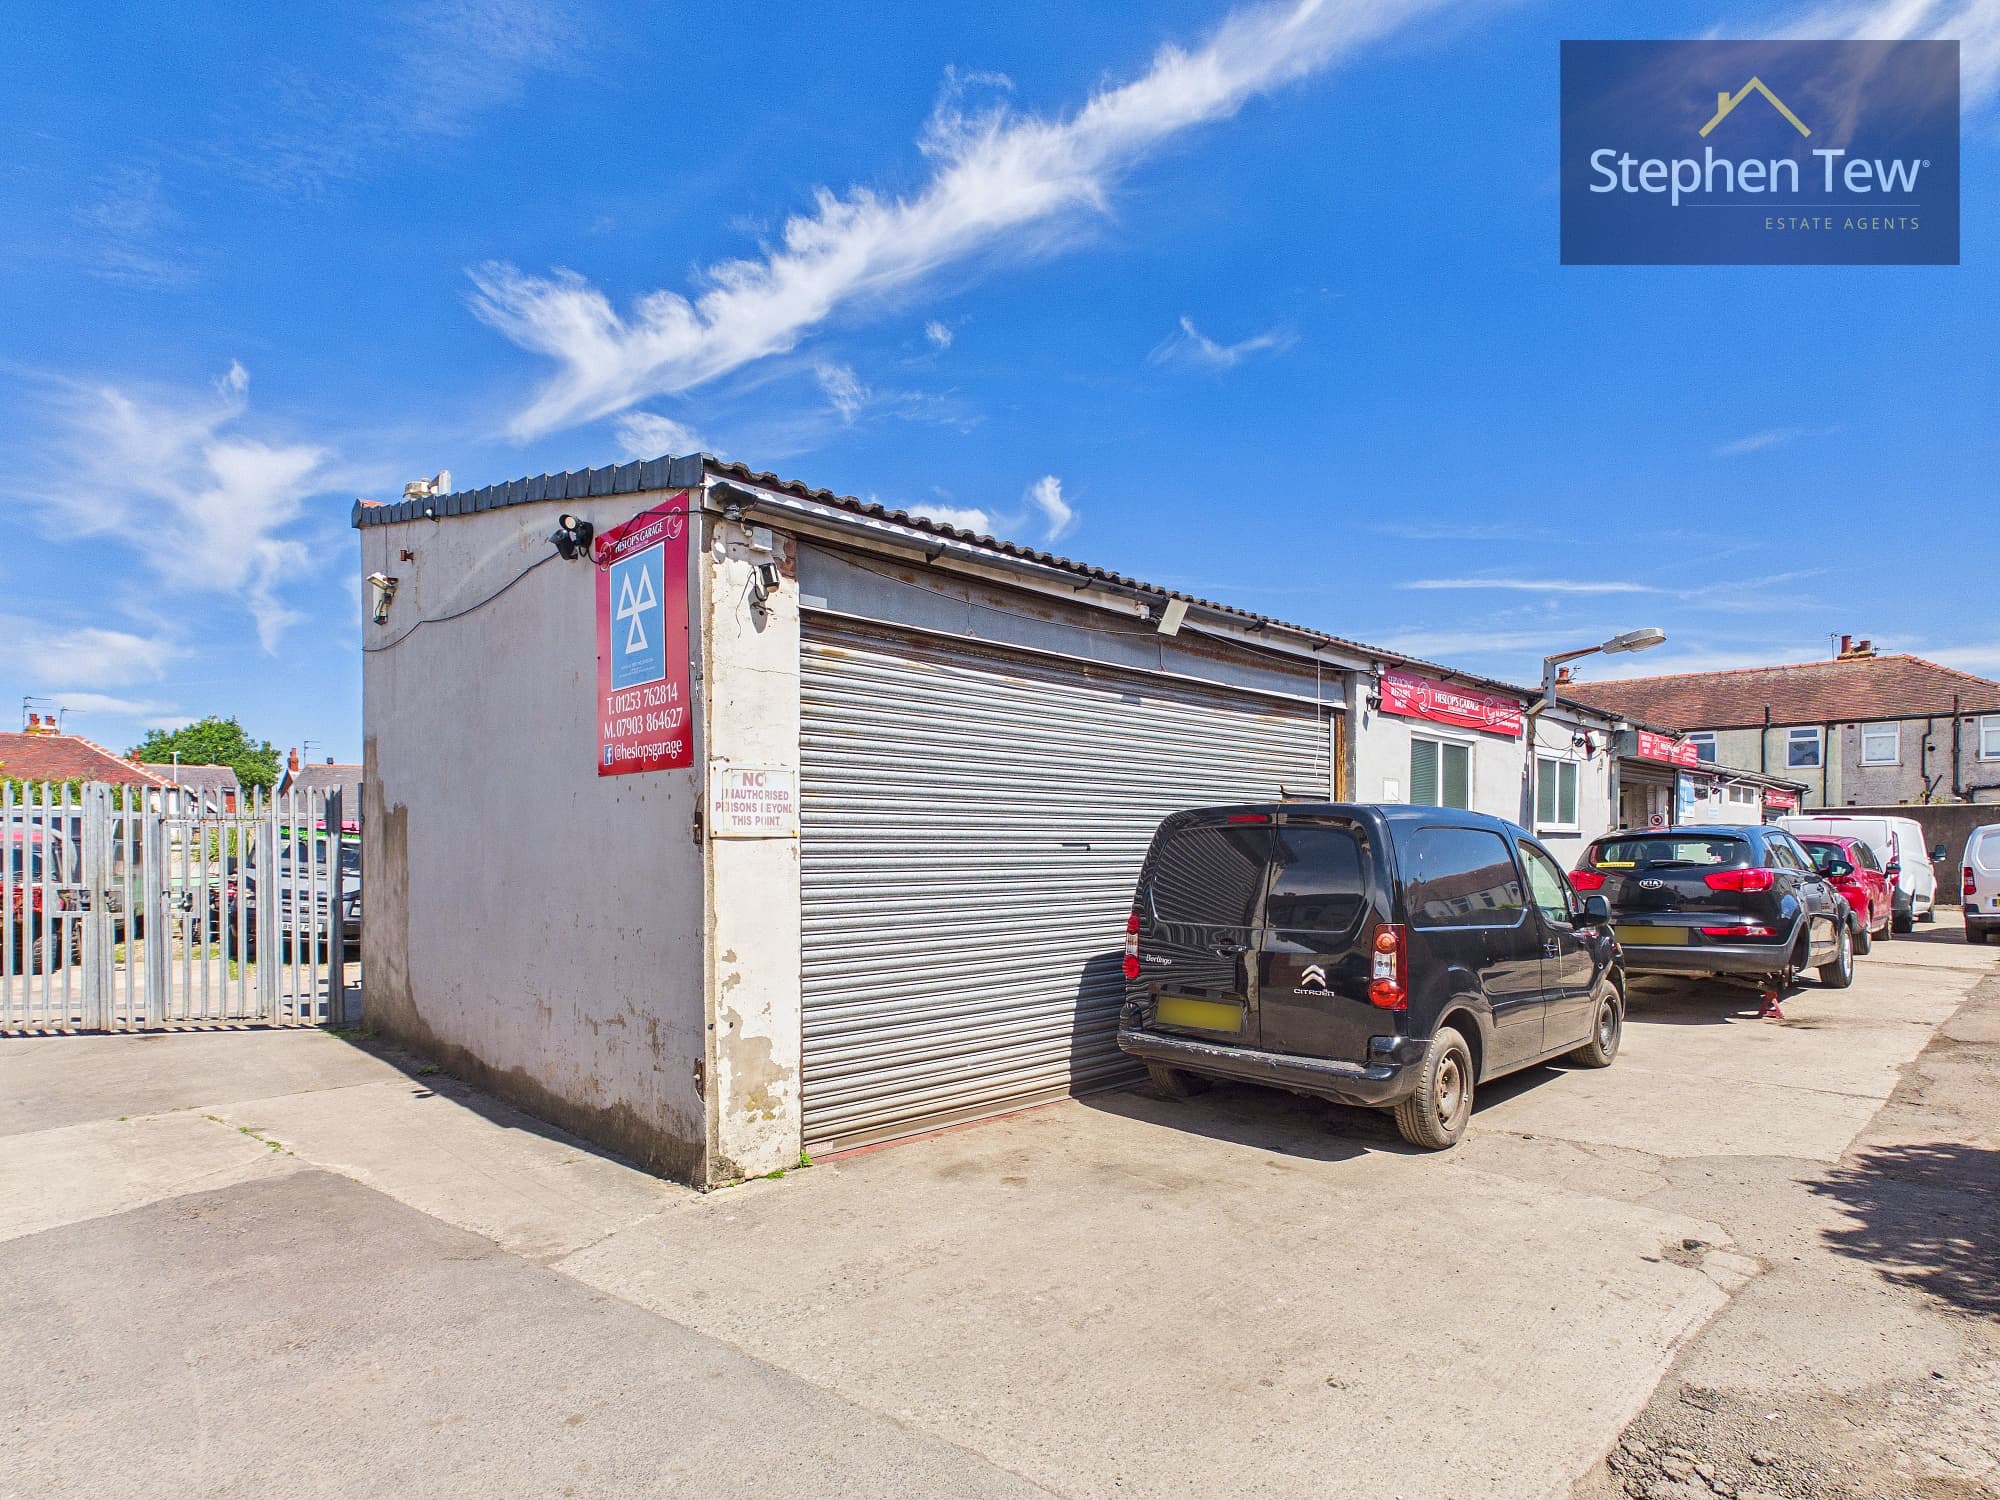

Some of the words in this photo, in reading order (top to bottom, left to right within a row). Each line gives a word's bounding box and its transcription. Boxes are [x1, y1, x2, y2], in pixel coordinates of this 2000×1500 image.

[639, 521, 664, 542] GARAGE
[643, 682, 678, 708] 762814
[603, 714, 643, 739] M.07903
[646, 707, 683, 732] 864627
[614, 739, 683, 763] @heslopsgarage
[725, 788, 789, 801] AUTHORISED
[731, 815, 752, 826] THIS
[1145, 953, 1172, 966] Berlingo
